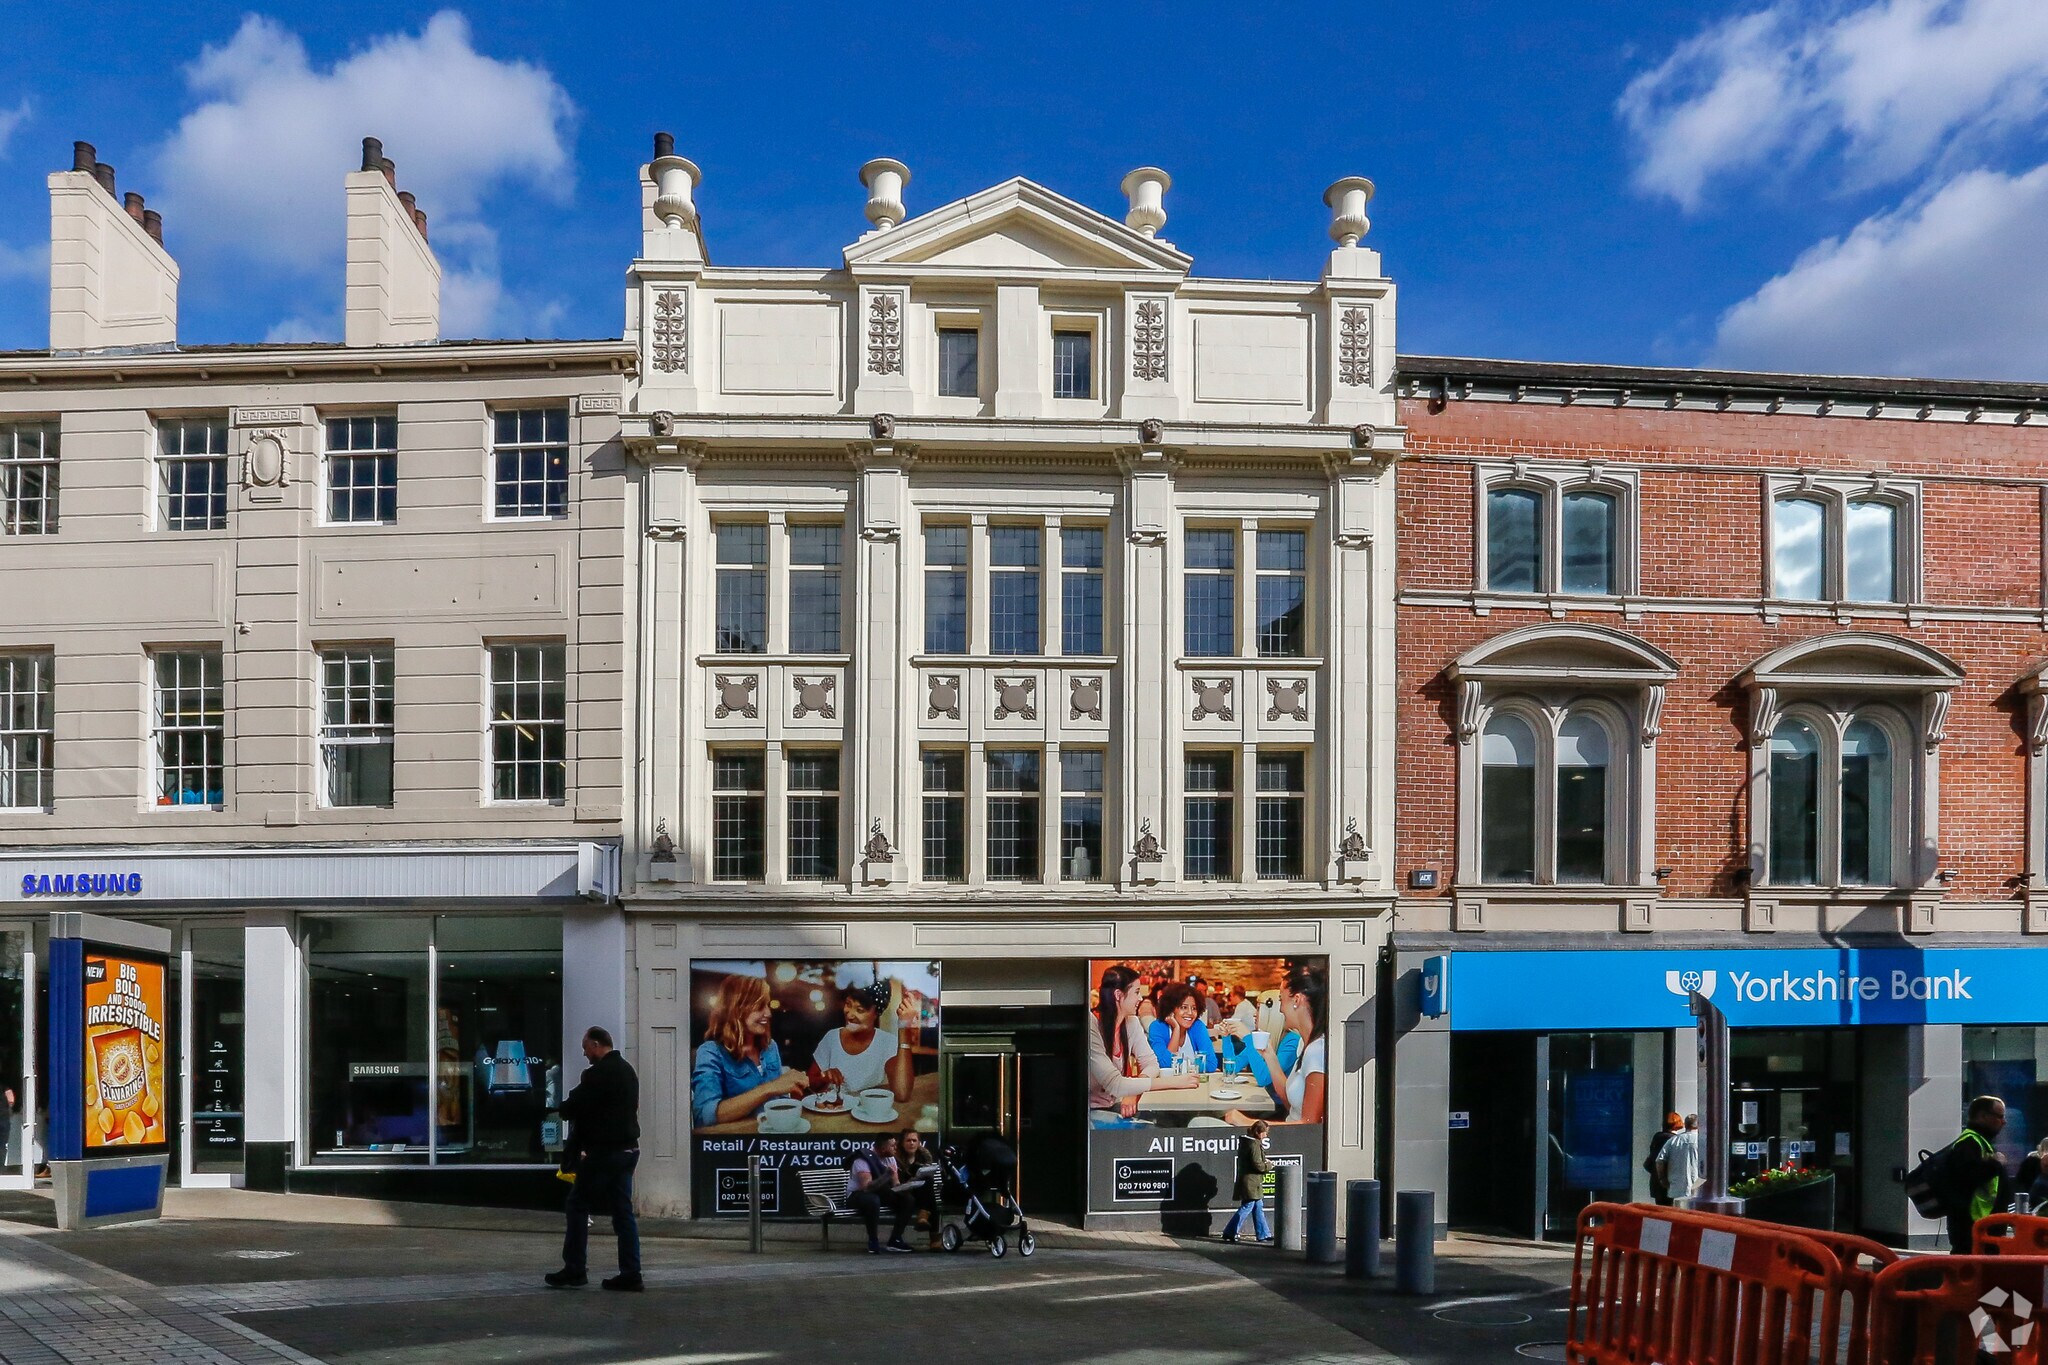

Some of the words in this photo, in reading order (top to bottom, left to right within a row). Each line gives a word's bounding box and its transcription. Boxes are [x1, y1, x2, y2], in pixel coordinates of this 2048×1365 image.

[22, 873, 142, 894] SAMSUNG
[86, 966, 105, 979] NEW
[120, 963, 137, 982] BIG
[115, 978, 141, 999] BOLD
[1728, 970, 1880, 1002] Yorkshire
[1891, 969, 1973, 1000] Bank
[107, 993, 123, 1005] AND
[124, 995, 147, 1014] SOOOO
[88, 1005, 160, 1041] IRRESISTIBLE
[483, 1056, 521, 1067] Galaxy
[353, 1066, 400, 1075] SAMSUNG
[702, 1139, 743, 1151] Retail
[760, 1139, 836, 1151] Restaurant
[1148, 1136, 1174, 1153] All
[1182, 1135, 1271, 1155] Enquis
[760, 1155, 774, 1166] A1
[790, 1155, 810, 1166] A3
[1118, 1182, 1132, 1190] 020
[1133, 1182, 1152, 1190] 7190
[1152, 1182, 1170, 1190] 9801
[721, 1193, 736, 1201] 020
